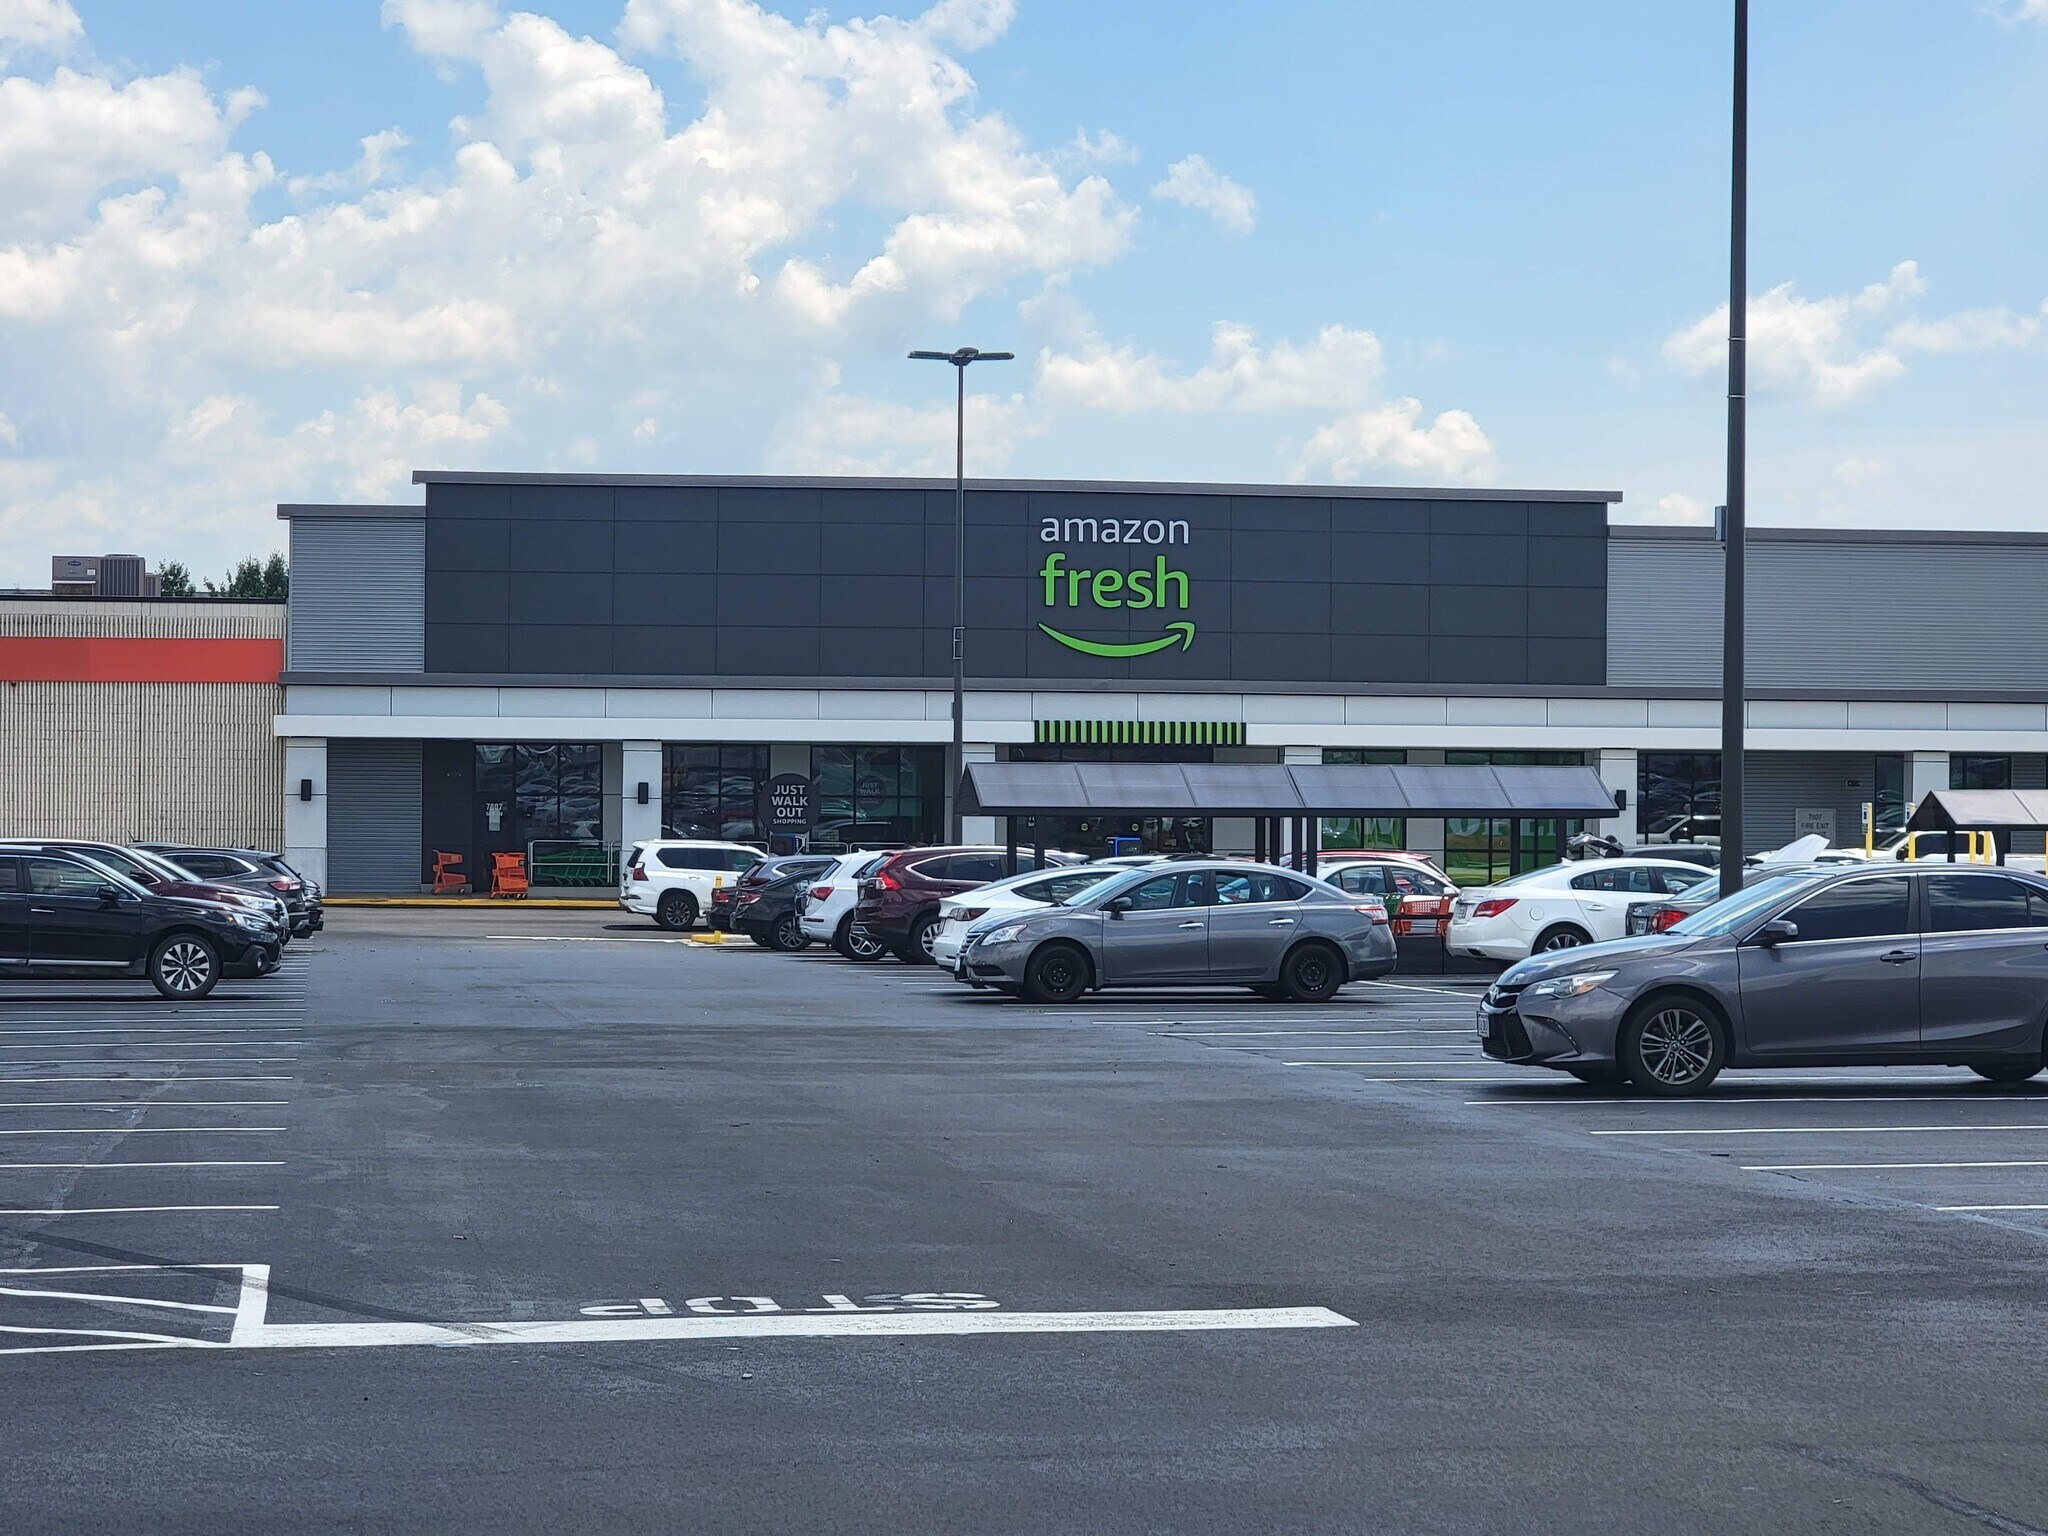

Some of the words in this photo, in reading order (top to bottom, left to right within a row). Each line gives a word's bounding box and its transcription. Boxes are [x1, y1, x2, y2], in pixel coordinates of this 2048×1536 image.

[1040, 517, 1190, 544] amazon
[1039, 552, 1189, 609] fresh
[774, 784, 806, 795] JUST
[485, 802, 503, 811] 7807
[771, 796, 809, 806] WALK
[776, 807, 804, 818] OUT
[1801, 822, 1815, 830] FIRE
[1816, 822, 1830, 830] EXIT
[579, 1291, 1001, 1317] STOP
